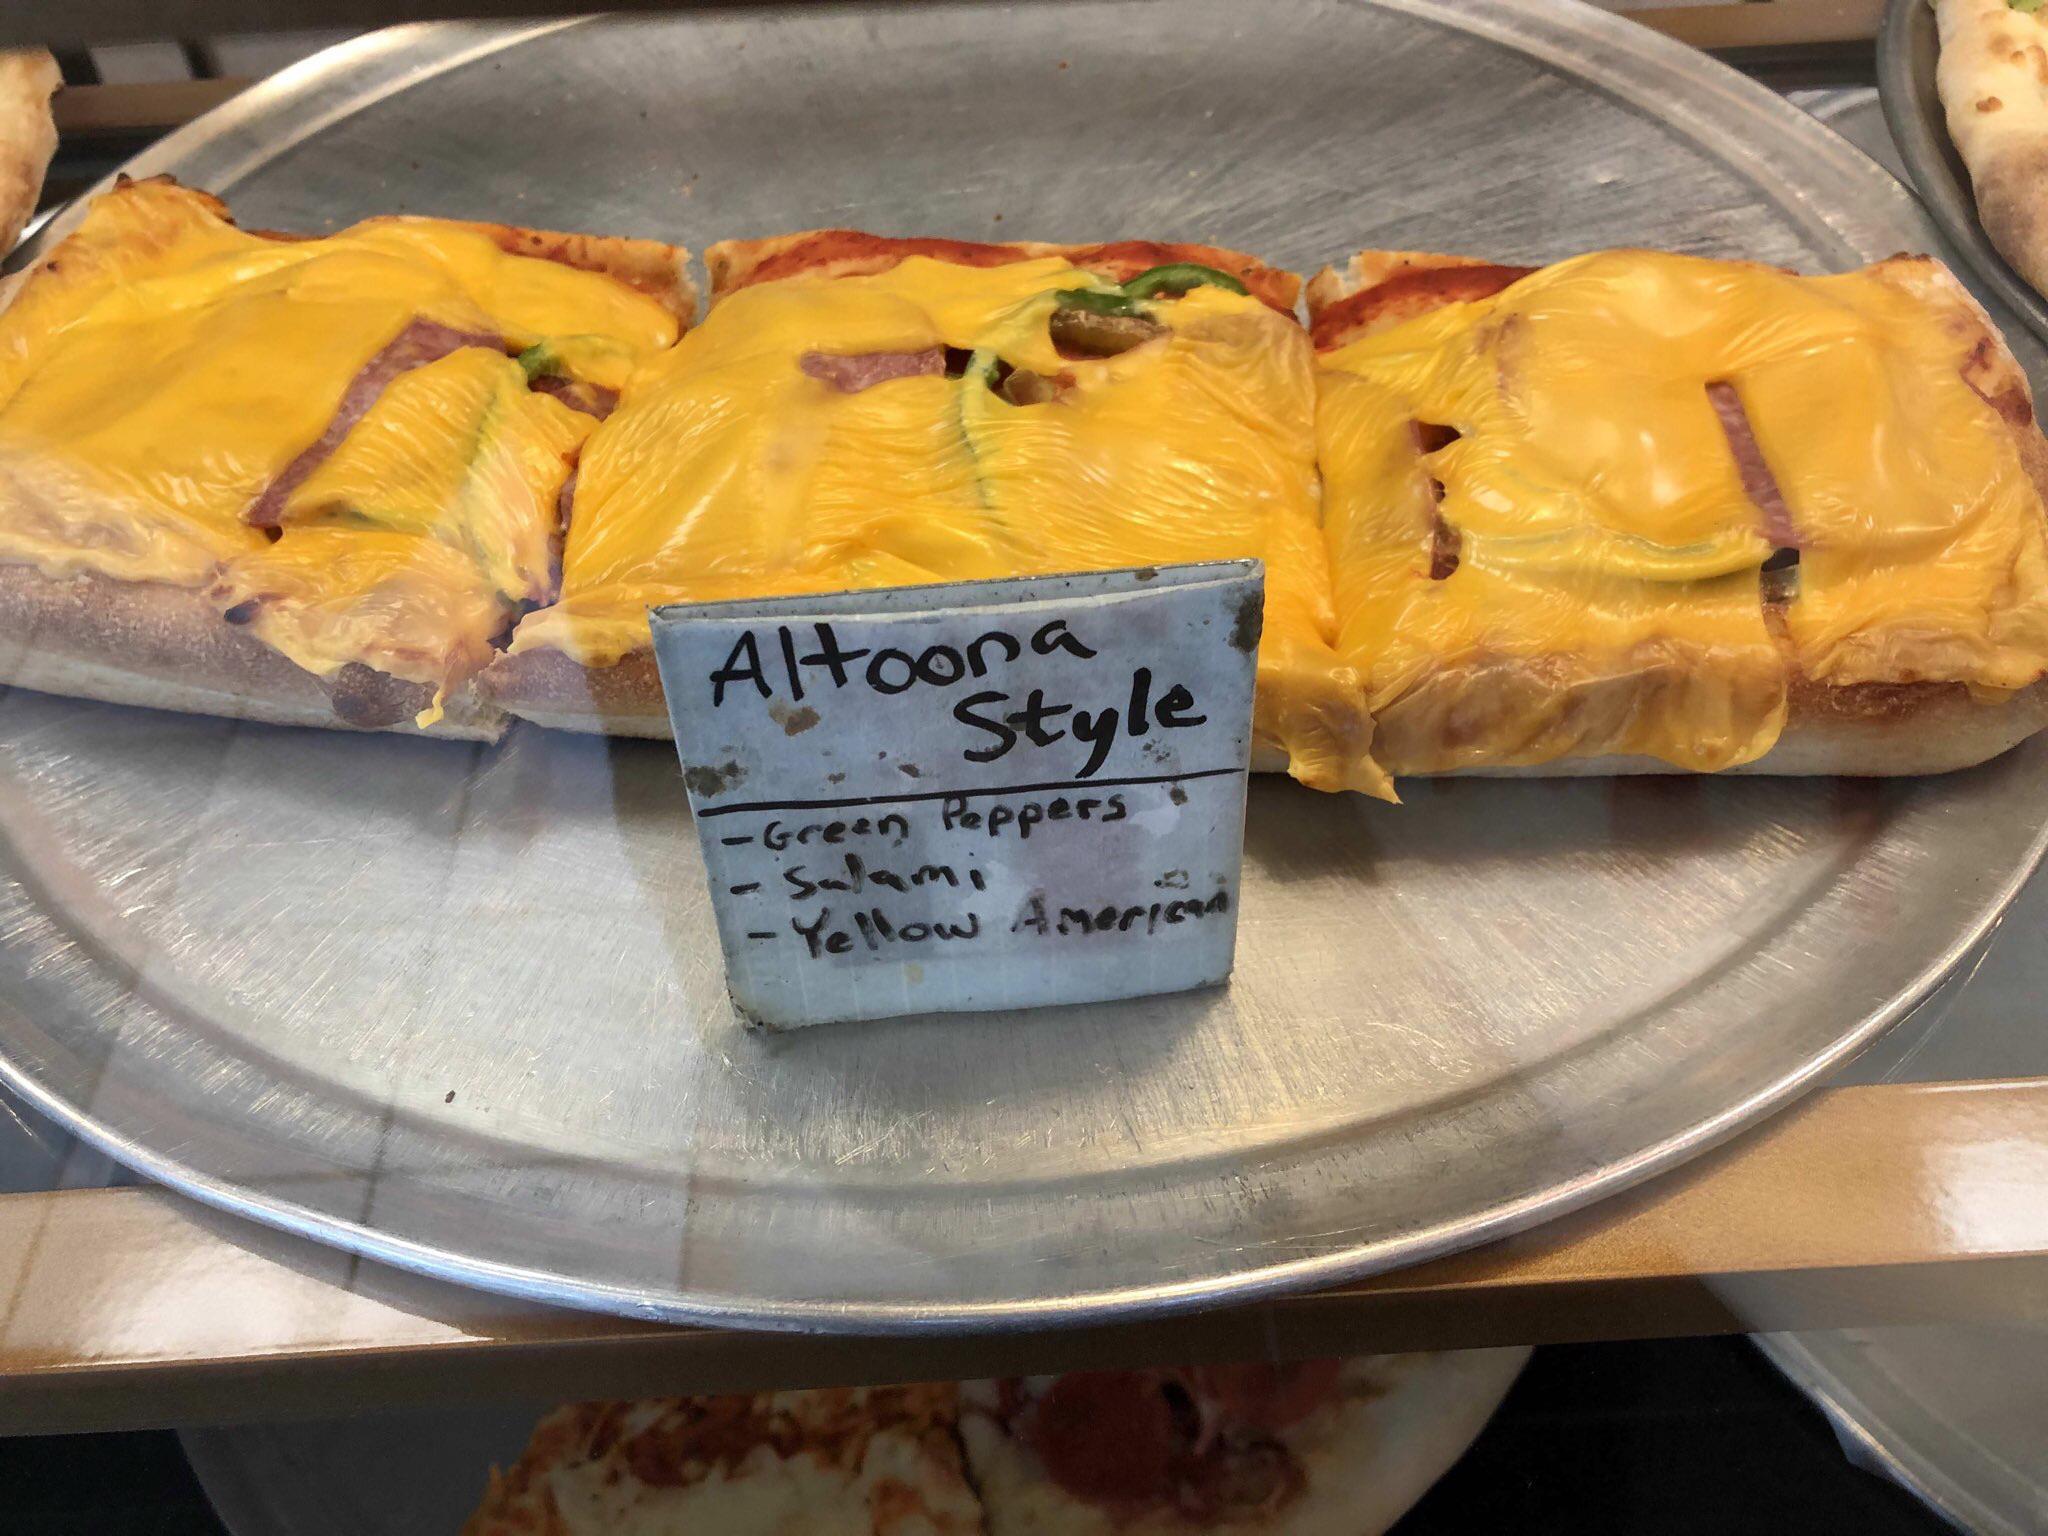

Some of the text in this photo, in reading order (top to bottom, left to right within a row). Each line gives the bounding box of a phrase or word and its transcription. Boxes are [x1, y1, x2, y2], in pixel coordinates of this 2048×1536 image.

[710, 620, 1098, 707] Altoona
[953, 667, 1208, 779] Style
[943, 791, 1127, 838] Peppers
[783, 853, 987, 900] Salami
[791, 908, 981, 959] Yellow
[1012, 889, 1231, 936] American
